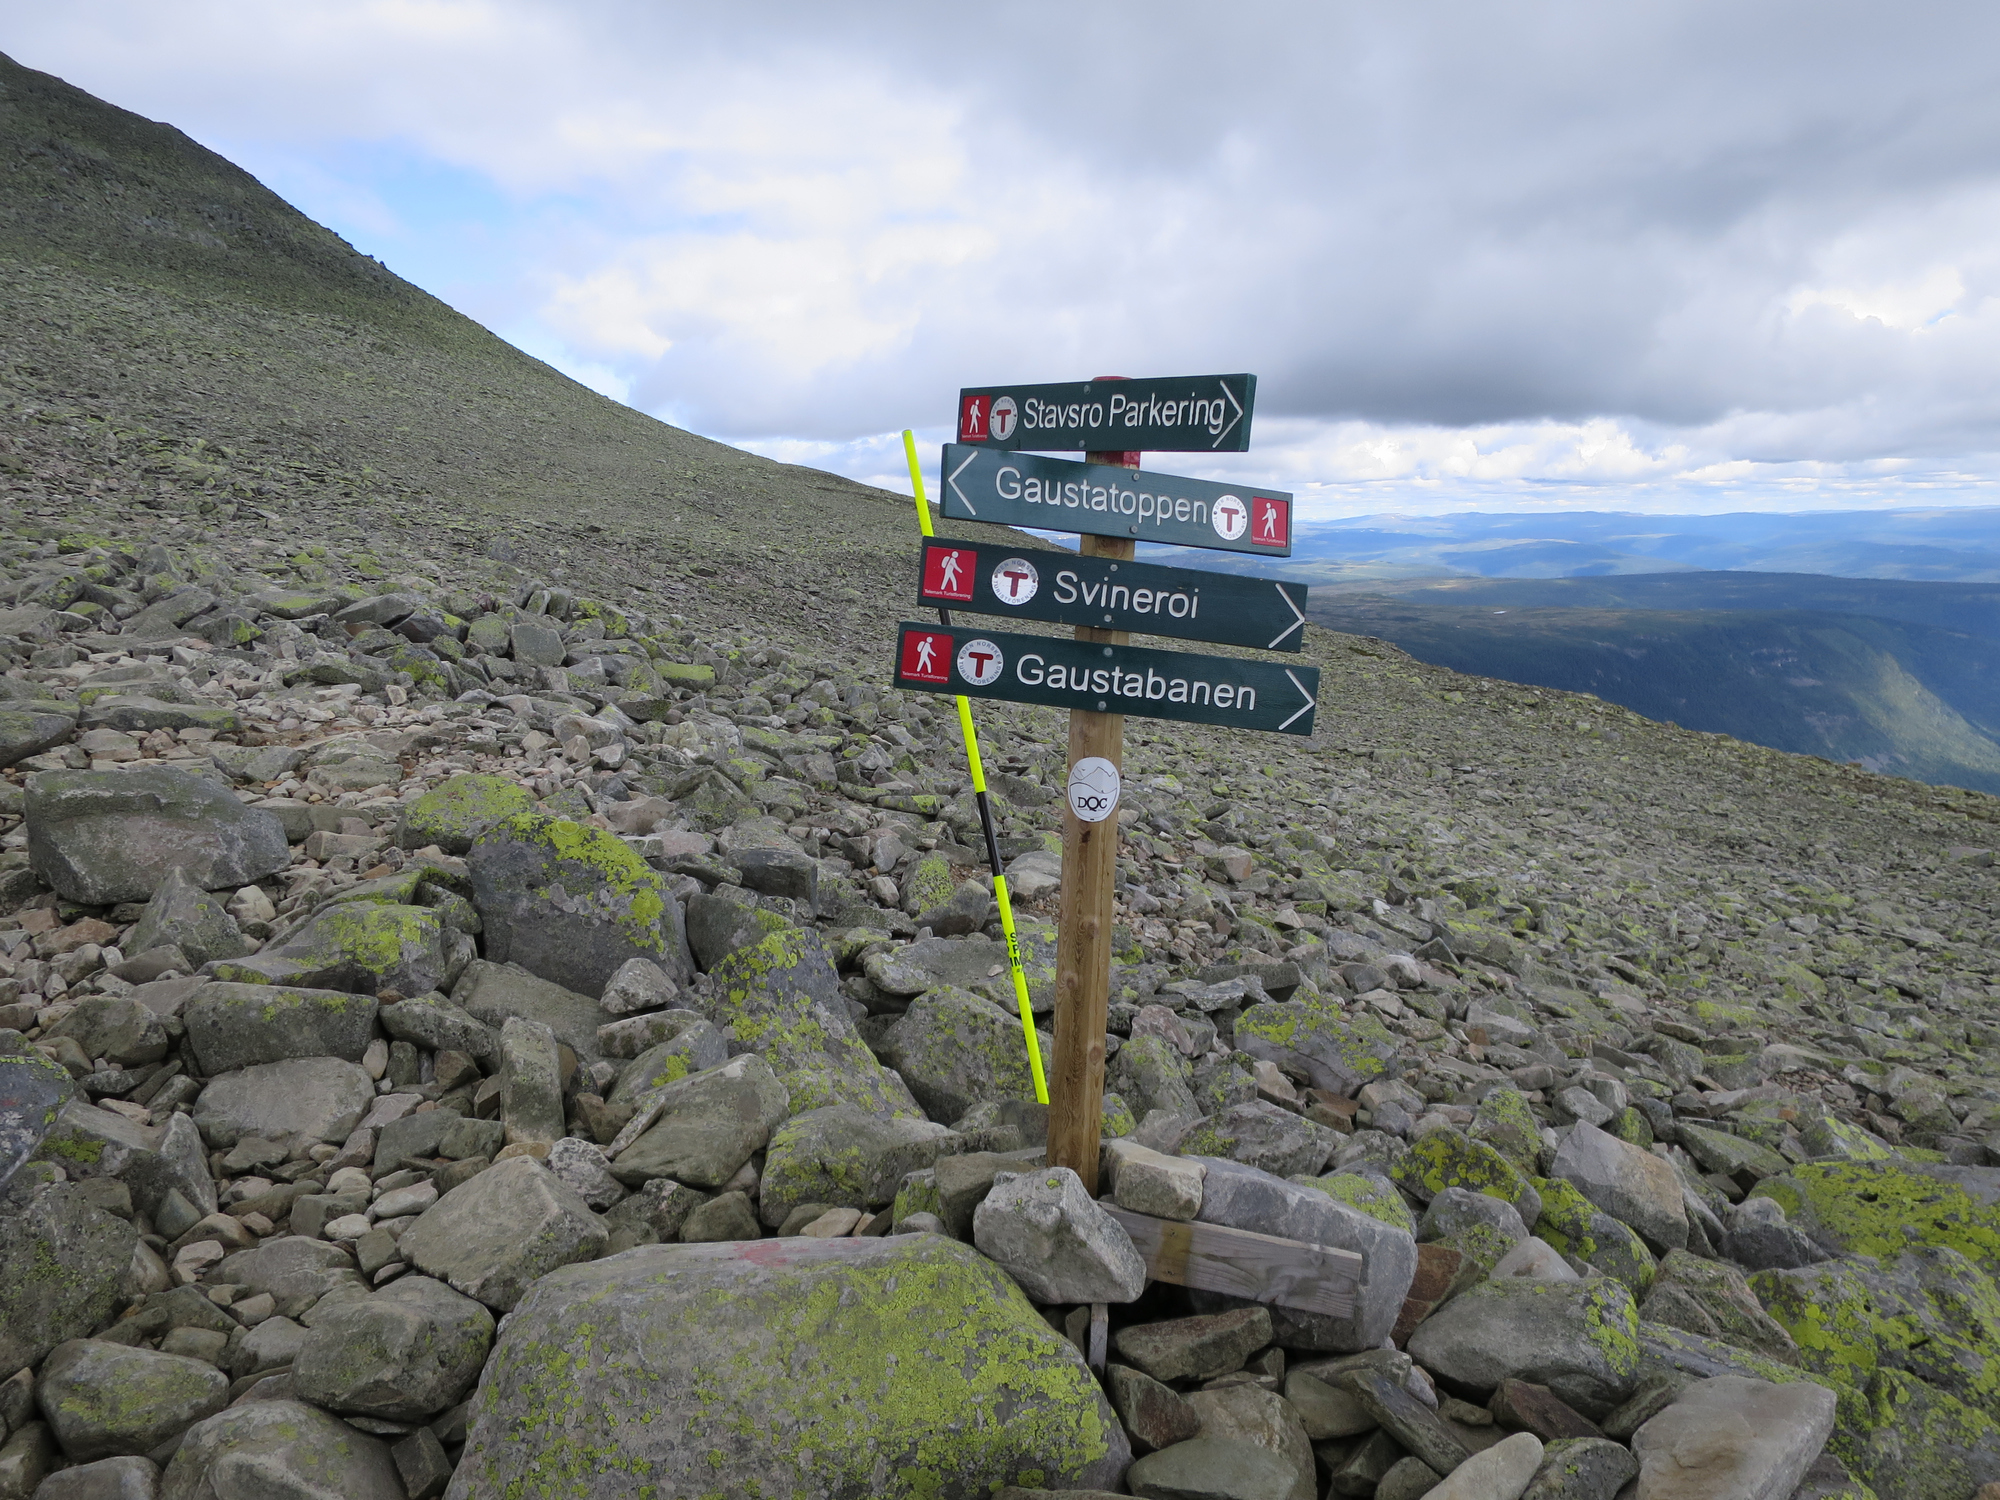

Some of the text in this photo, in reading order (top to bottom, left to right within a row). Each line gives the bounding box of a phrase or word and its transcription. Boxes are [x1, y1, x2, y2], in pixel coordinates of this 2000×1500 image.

[996, 409, 1012, 434] T
[1023, 391, 1226, 435] Stavsro Parkering
[995, 466, 1208, 526] Gaustatoppen
[1220, 506, 1240, 533] T
[996, 562, 1010, 575] DEN
[1003, 570, 1029, 598] T
[1053, 570, 1200, 619] Svineroi
[961, 641, 1002, 659] DEN NORSKE
[968, 651, 994, 679] T
[1016, 653, 1256, 711] Gaustabanen
